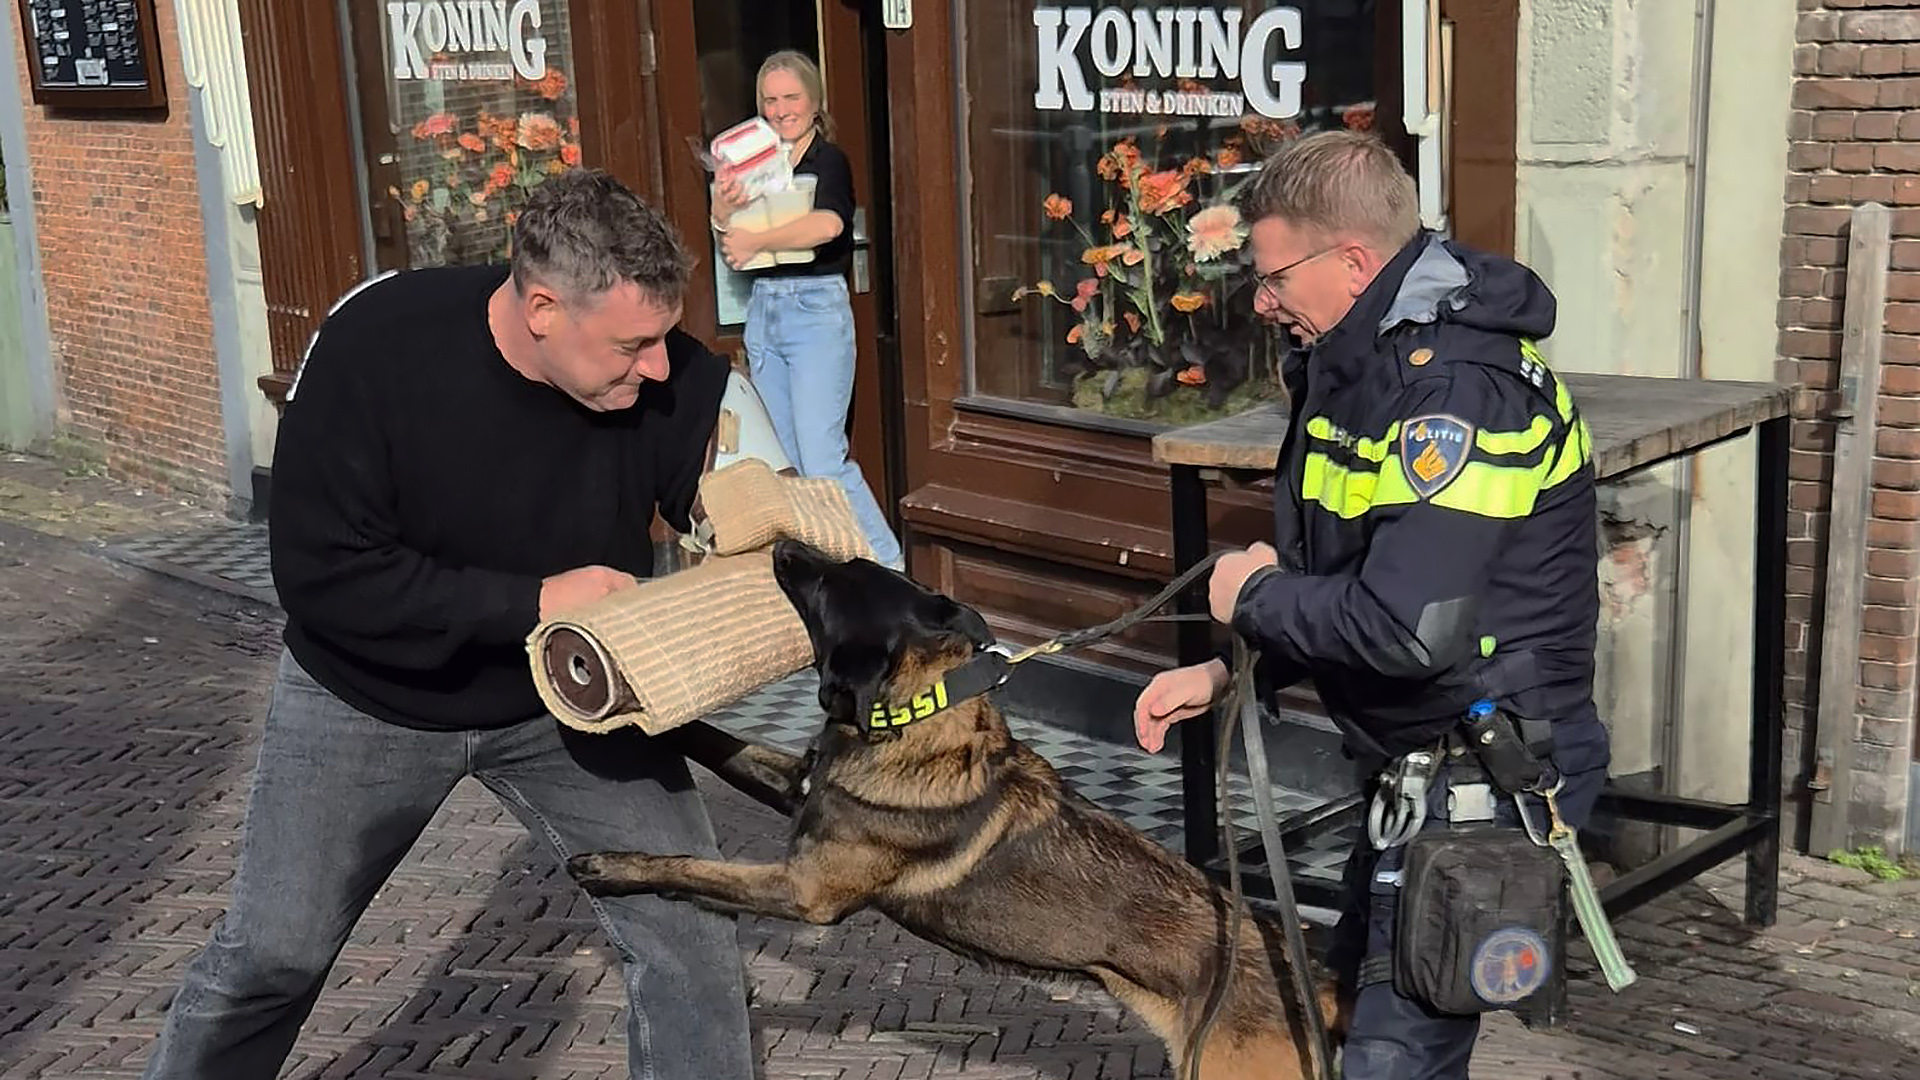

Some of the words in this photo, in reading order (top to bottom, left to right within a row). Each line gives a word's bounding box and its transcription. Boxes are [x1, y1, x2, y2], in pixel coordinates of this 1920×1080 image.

[386, 0, 547, 80] KONING
[1033, 7, 1306, 119] KONING
[1100, 89, 1145, 113] ETEN
[1146, 90, 1162, 114] &
[1163, 91, 1244, 117] DRINKEN
